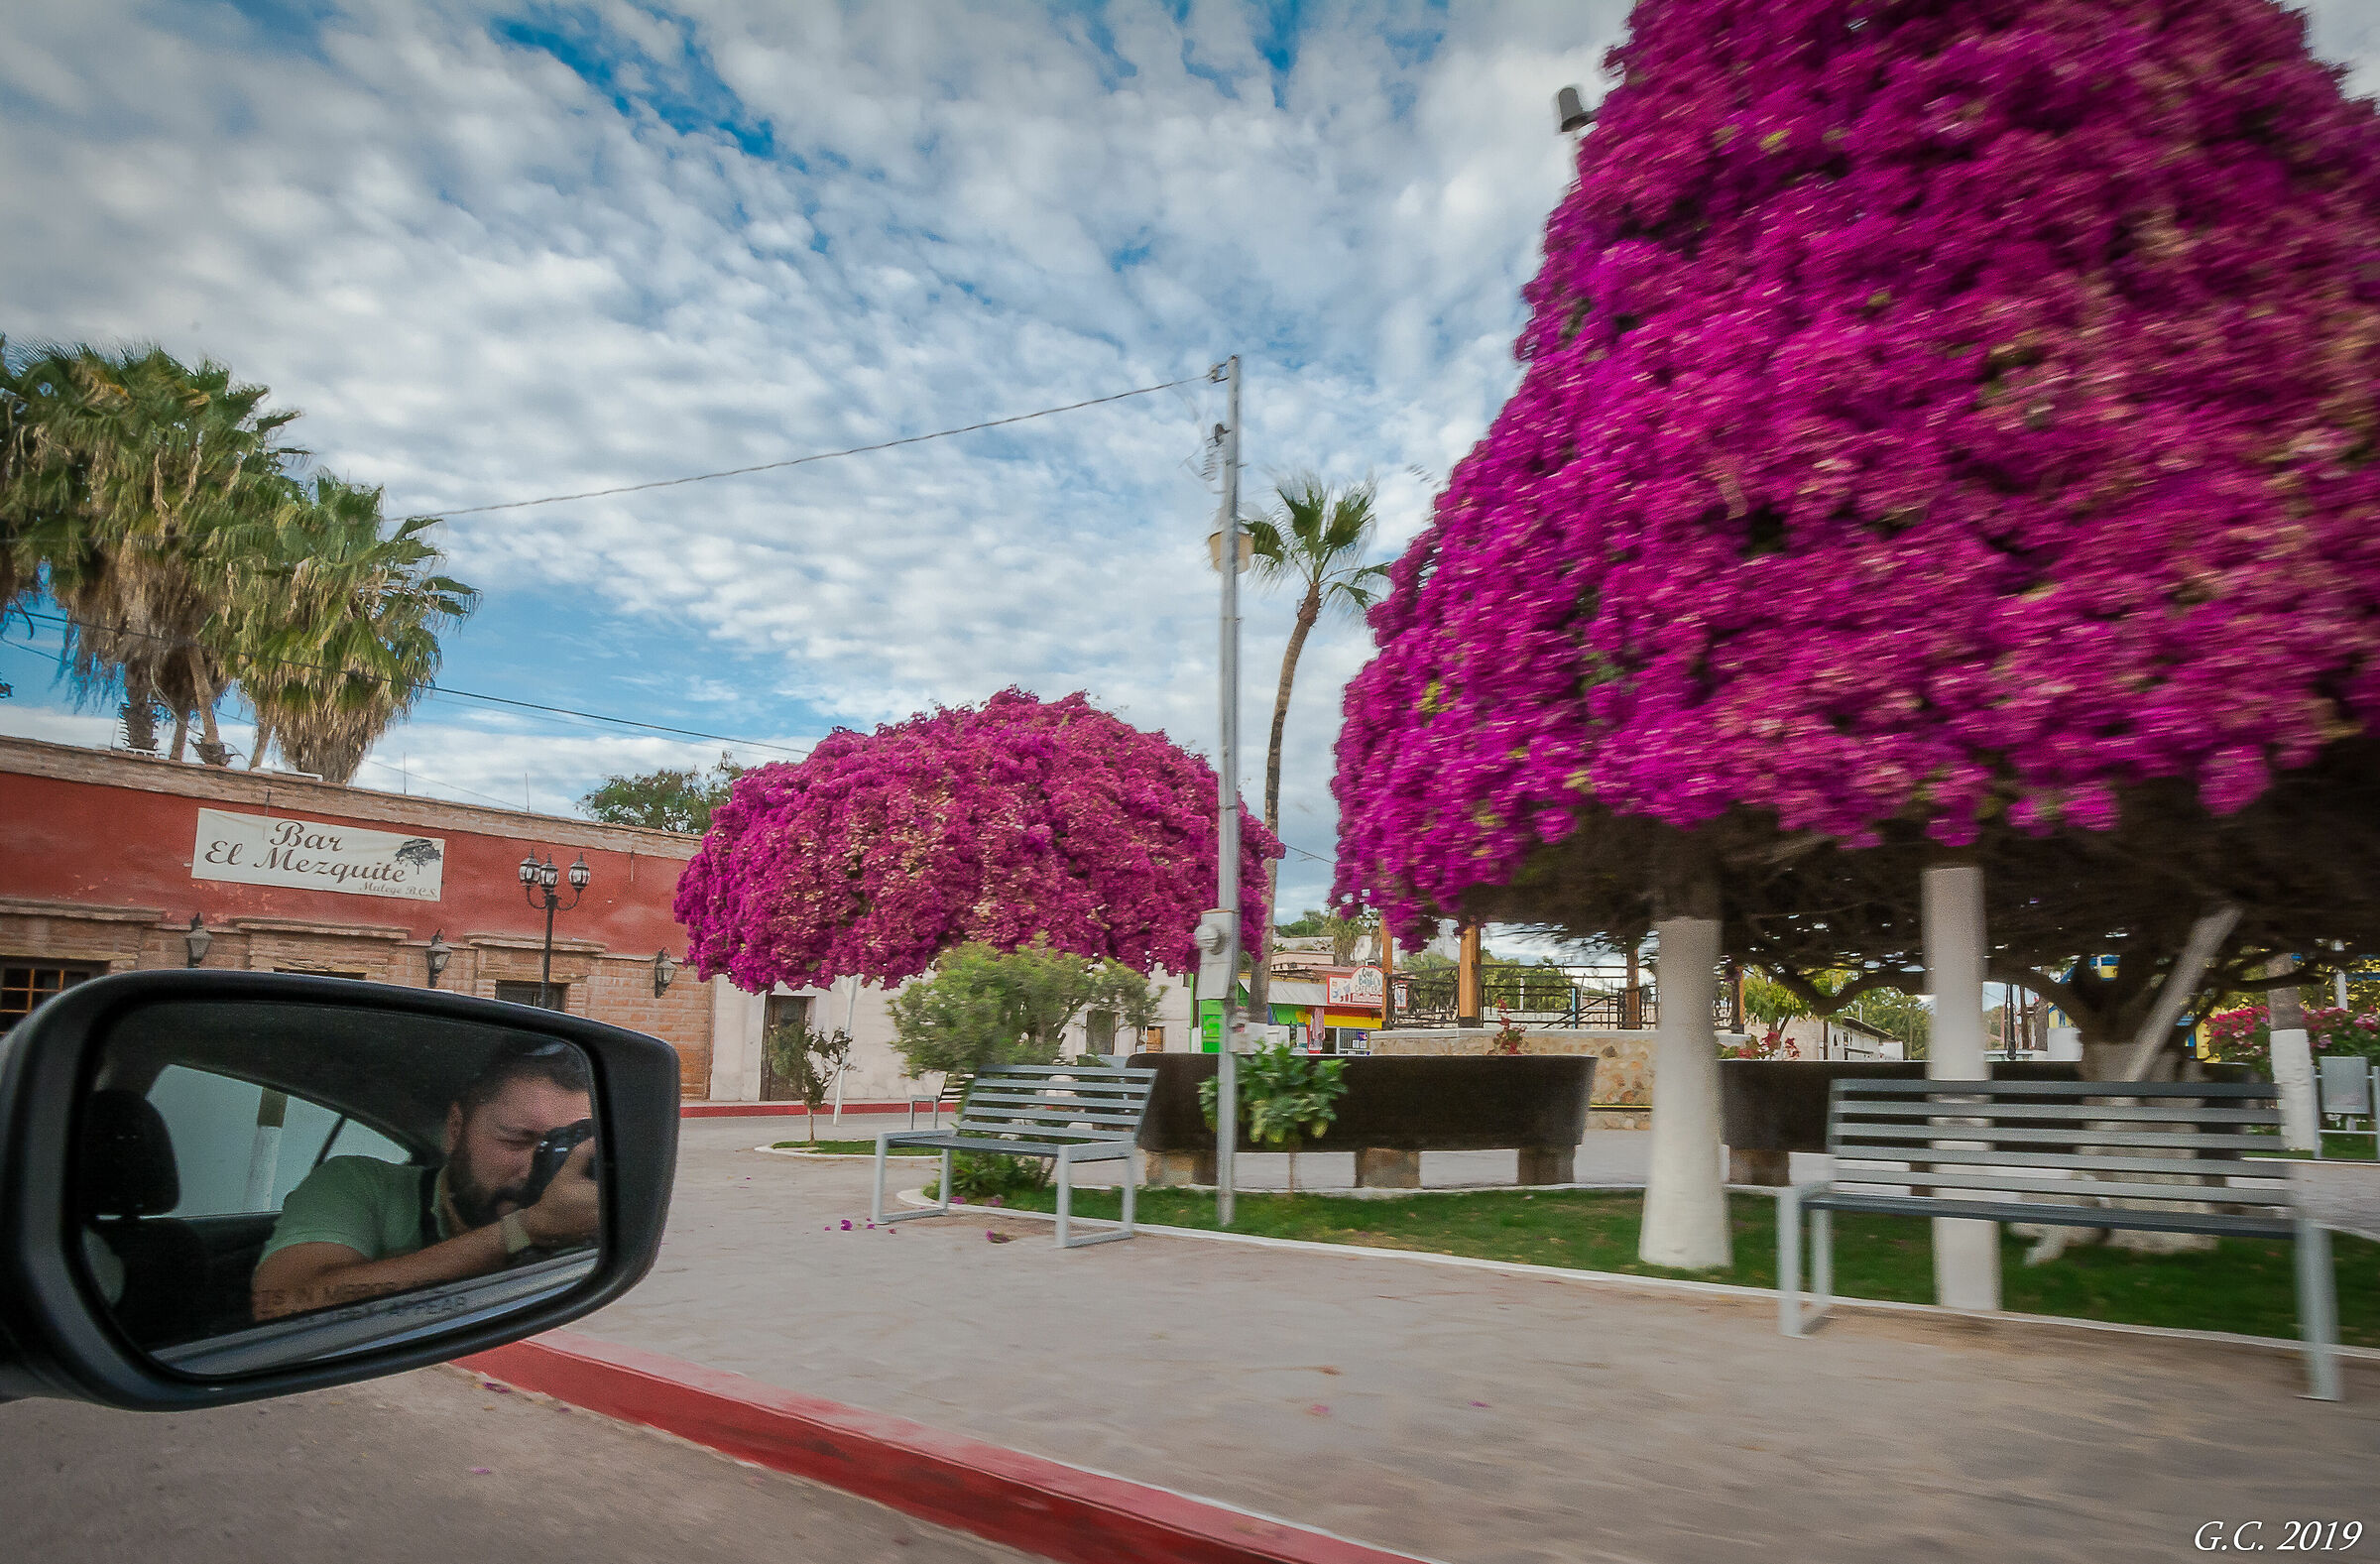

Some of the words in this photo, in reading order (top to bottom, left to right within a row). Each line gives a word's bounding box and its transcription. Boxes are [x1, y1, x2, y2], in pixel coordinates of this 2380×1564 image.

[270, 820, 343, 852] Bar
[204, 840, 244, 866] El
[254, 847, 407, 884] Mezquite
